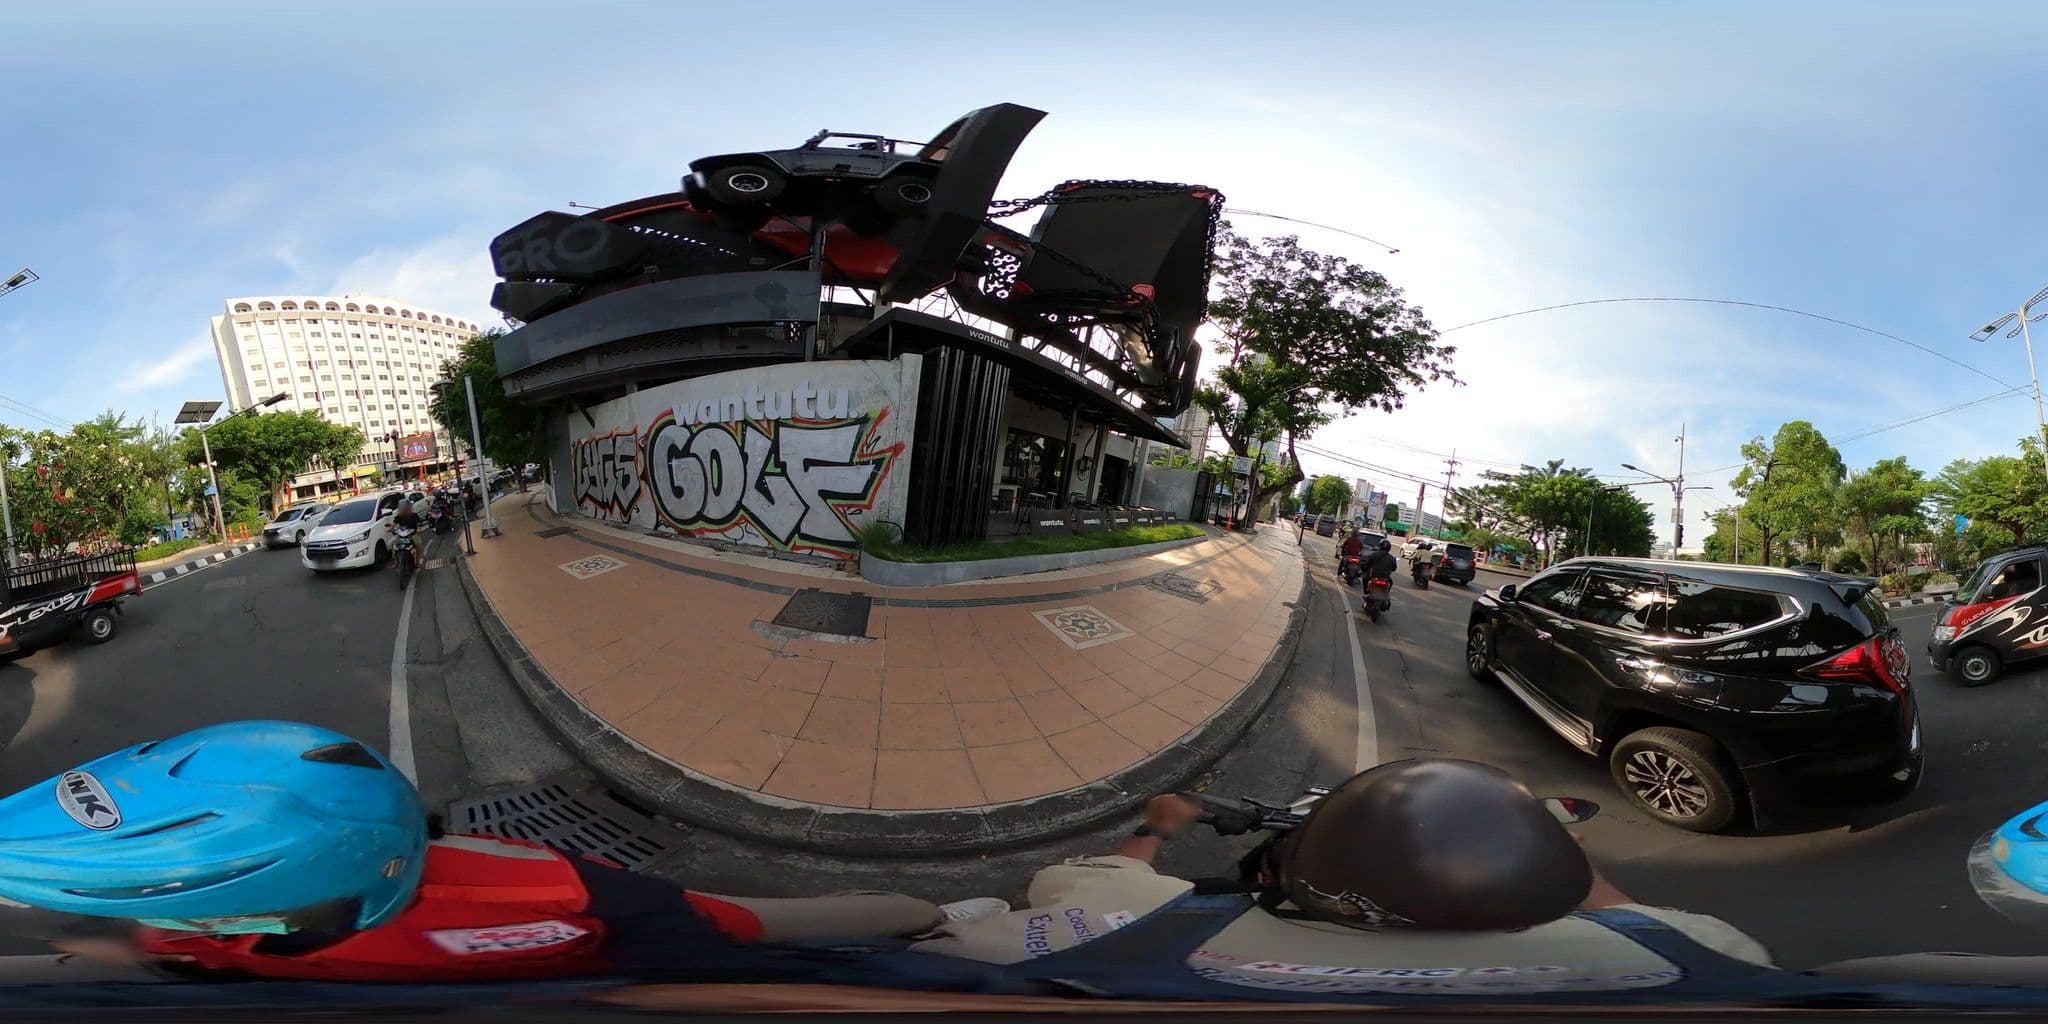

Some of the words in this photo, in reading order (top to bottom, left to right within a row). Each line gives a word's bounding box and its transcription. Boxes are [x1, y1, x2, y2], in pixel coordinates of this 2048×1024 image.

[671, 379, 862, 427] wantutu.
[652, 422, 877, 546] GOLF
[17, 592, 76, 625] LEXUS
